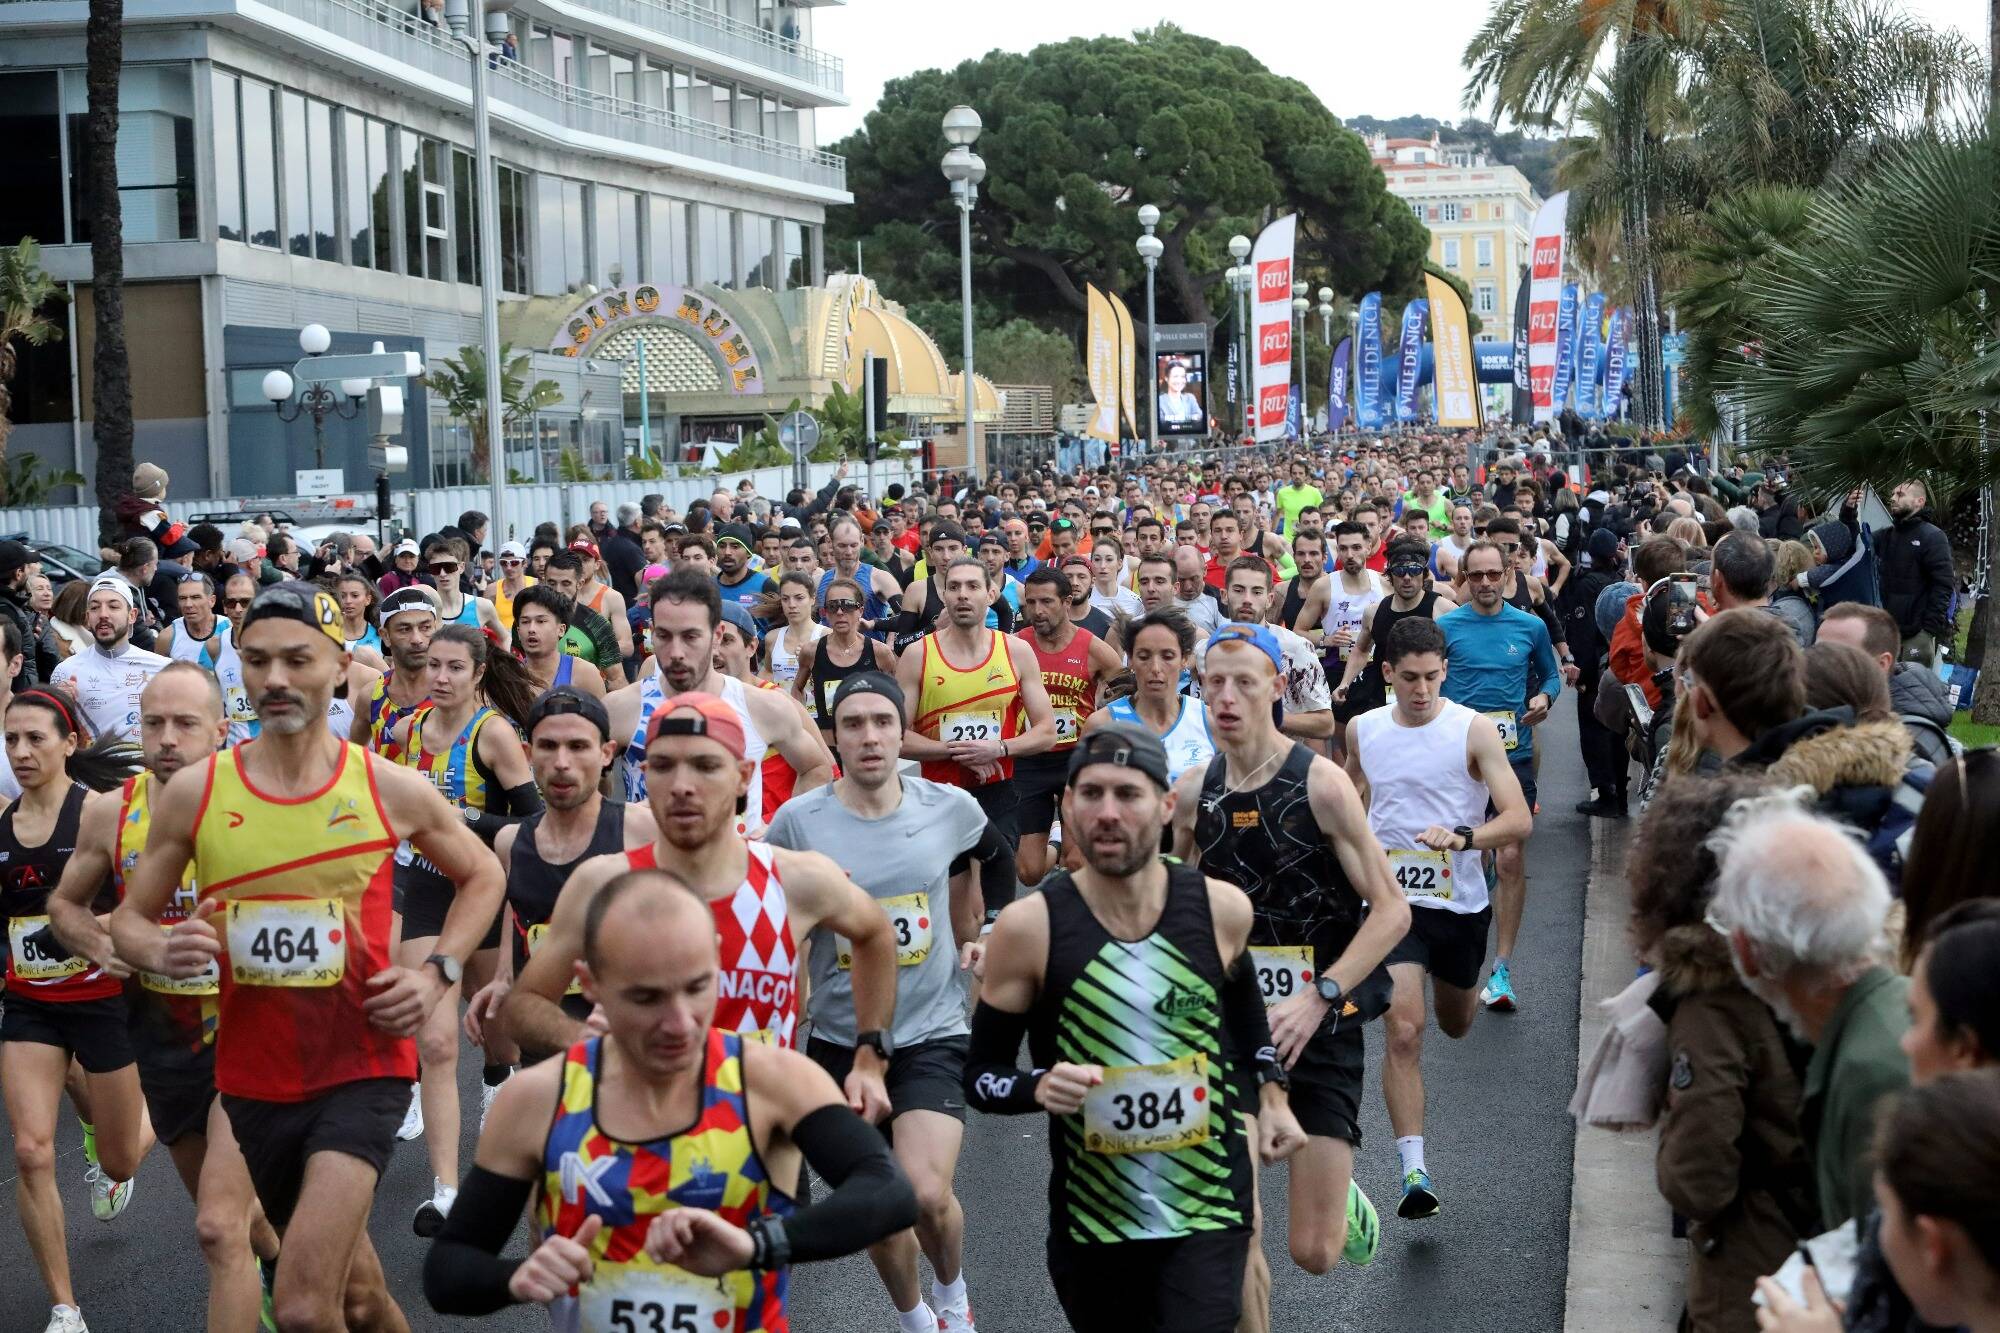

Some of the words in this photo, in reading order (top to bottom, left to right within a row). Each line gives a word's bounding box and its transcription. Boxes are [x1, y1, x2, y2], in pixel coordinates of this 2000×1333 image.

[1407, 313, 1422, 346] NICE
[1560, 295, 1574, 330] NICE
[1586, 303, 1600, 337] NICE
[676, 294, 757, 392] RUHL
[1365, 344, 1379, 363] DE
[1404, 348, 1417, 366] DE
[1365, 367, 1379, 408] VILLE
[1401, 369, 1415, 404] VILLE
[1580, 362, 1595, 400] VILLE
[1262, 394, 1287, 413] RTL2
[1395, 865, 1436, 889] 422
[251, 926, 319, 963] 464
[1112, 1086, 1185, 1131] 384
[610, 1299, 698, 1333] 535
